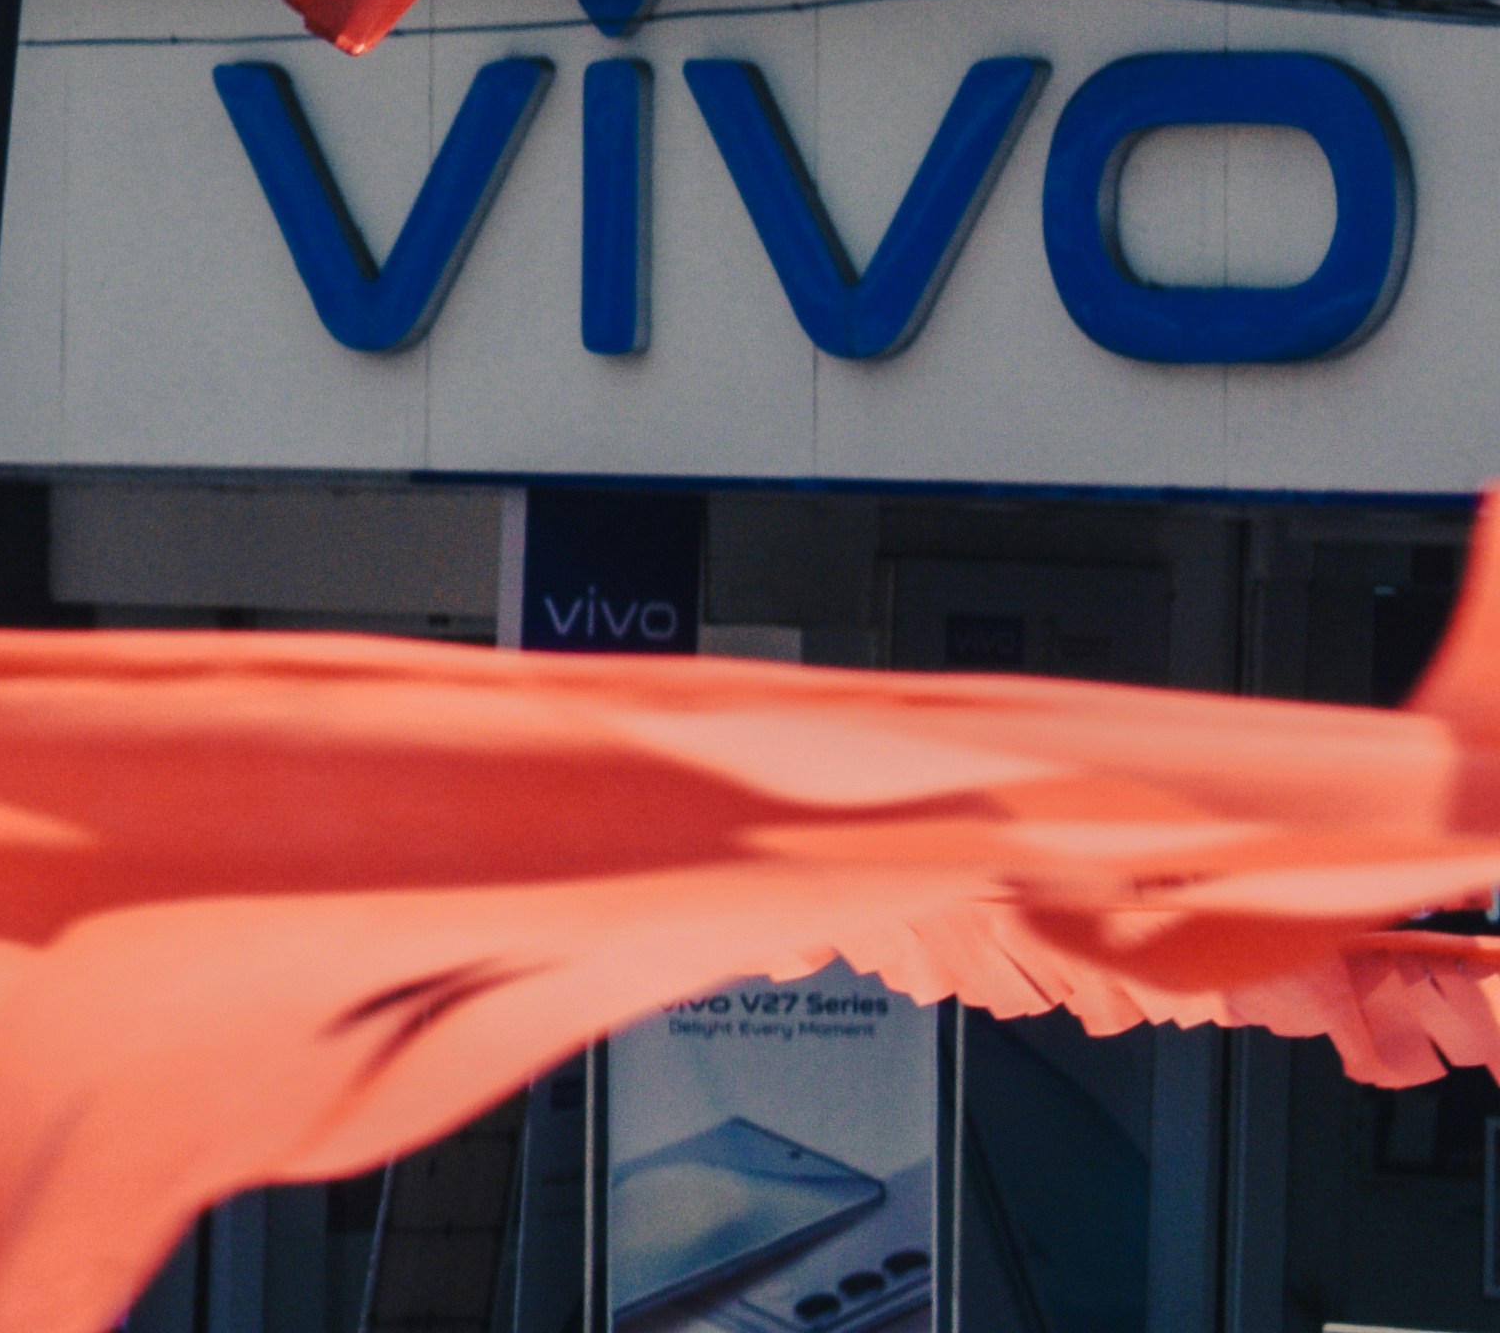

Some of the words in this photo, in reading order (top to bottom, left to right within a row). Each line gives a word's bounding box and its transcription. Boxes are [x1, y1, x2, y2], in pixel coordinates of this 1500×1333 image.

[543, 584, 678, 642] vivo
[739, 992, 799, 1015] V27
[806, 992, 889, 1015] Series
